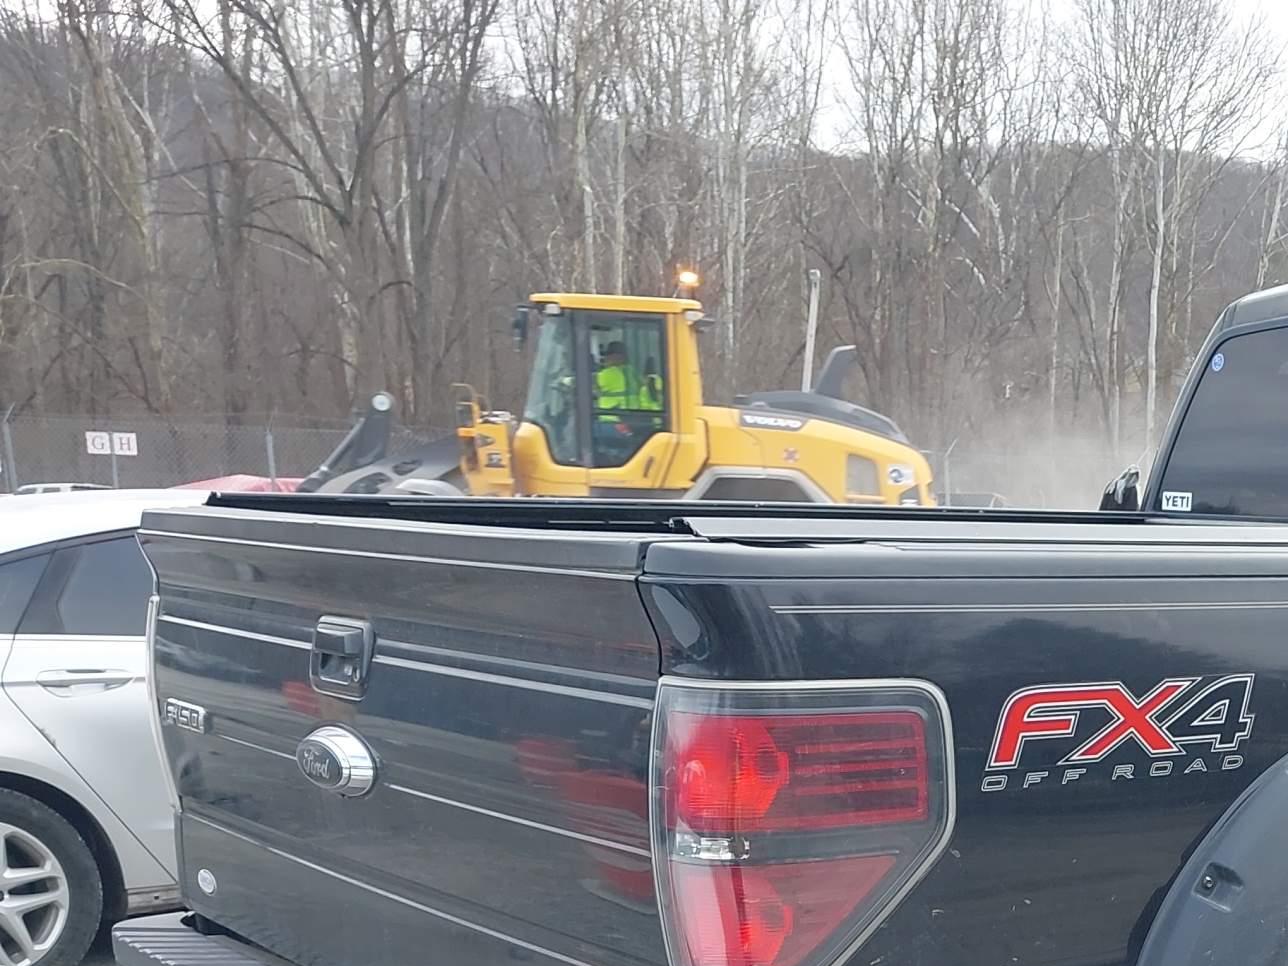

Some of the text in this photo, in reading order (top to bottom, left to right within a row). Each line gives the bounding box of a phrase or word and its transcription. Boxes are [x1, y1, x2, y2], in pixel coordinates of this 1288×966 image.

[742, 415, 802, 428] VOLVO
[92, 435, 131, 451] G H
[1165, 495, 1190, 508] YETI
[984, 673, 1255, 771] FX4
[302, 748, 330, 779] Ford
[981, 754, 1245, 792] OFF ROAD
